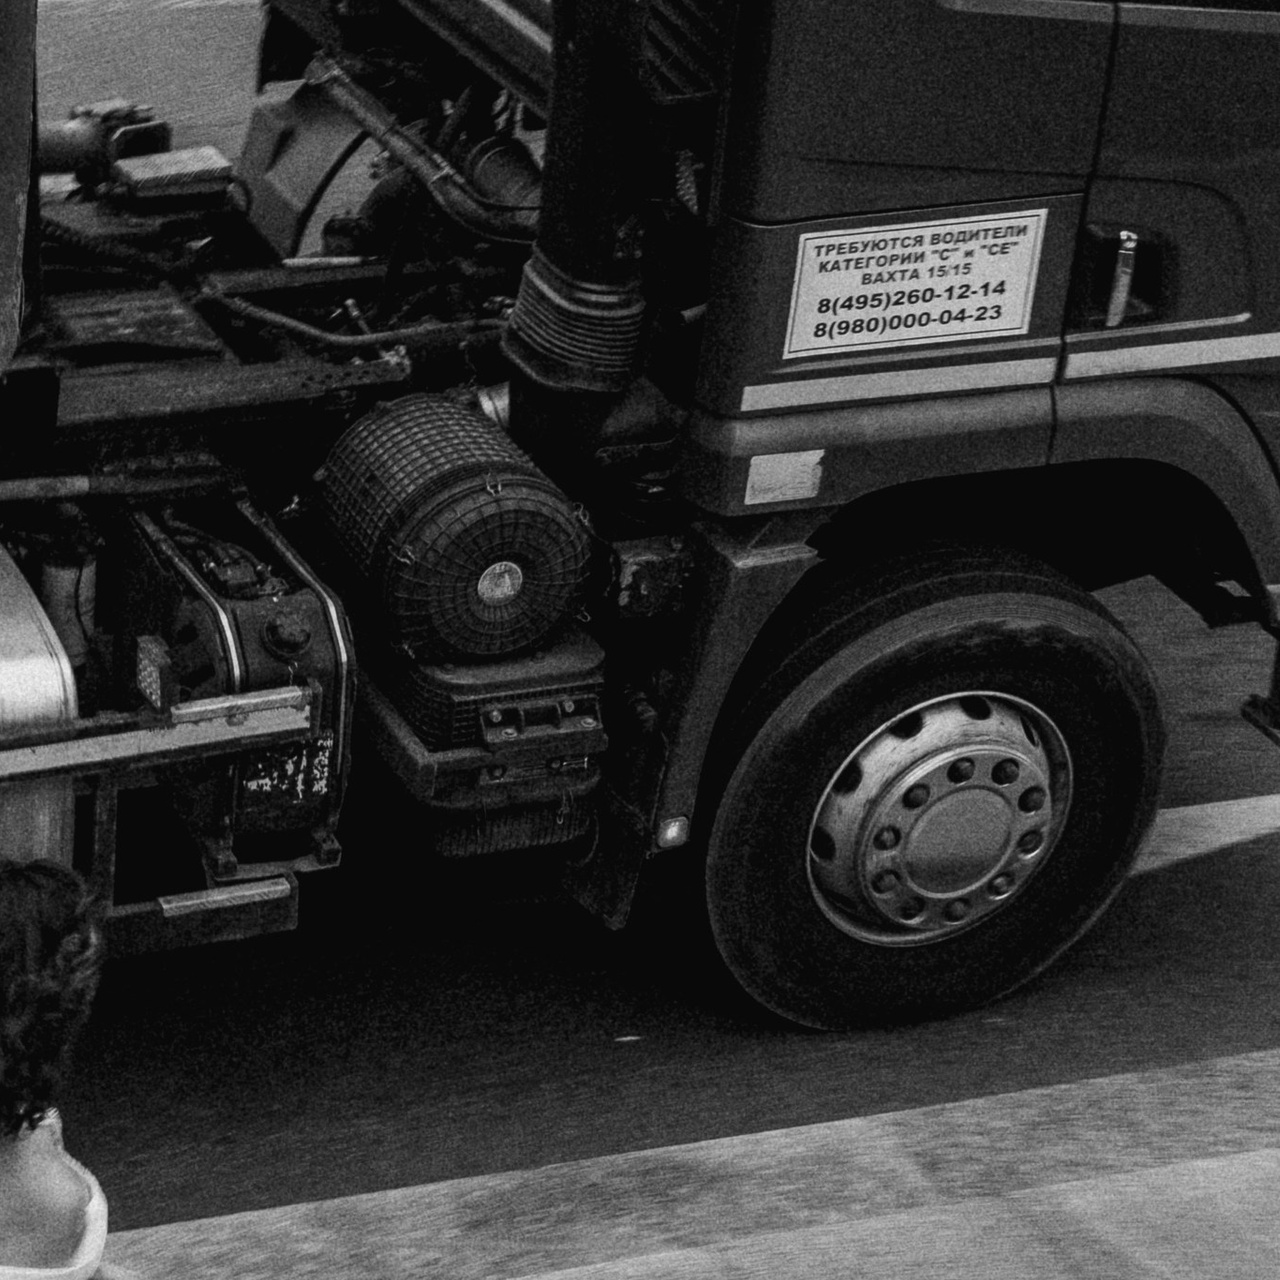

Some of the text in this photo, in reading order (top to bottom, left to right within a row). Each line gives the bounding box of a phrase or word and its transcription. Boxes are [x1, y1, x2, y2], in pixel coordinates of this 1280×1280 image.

[814, 224, 1029, 258] ТРЕБУЮТСЯ ВОДИТЕЛИ
[818, 252, 925, 274] КАТЕГОРИИ
[861, 262, 972, 286] ВАХТА 15/15
[817, 280, 1007, 316] 8(495)260-12-14
[813, 305, 1003, 339] 8(980)000-04-23
